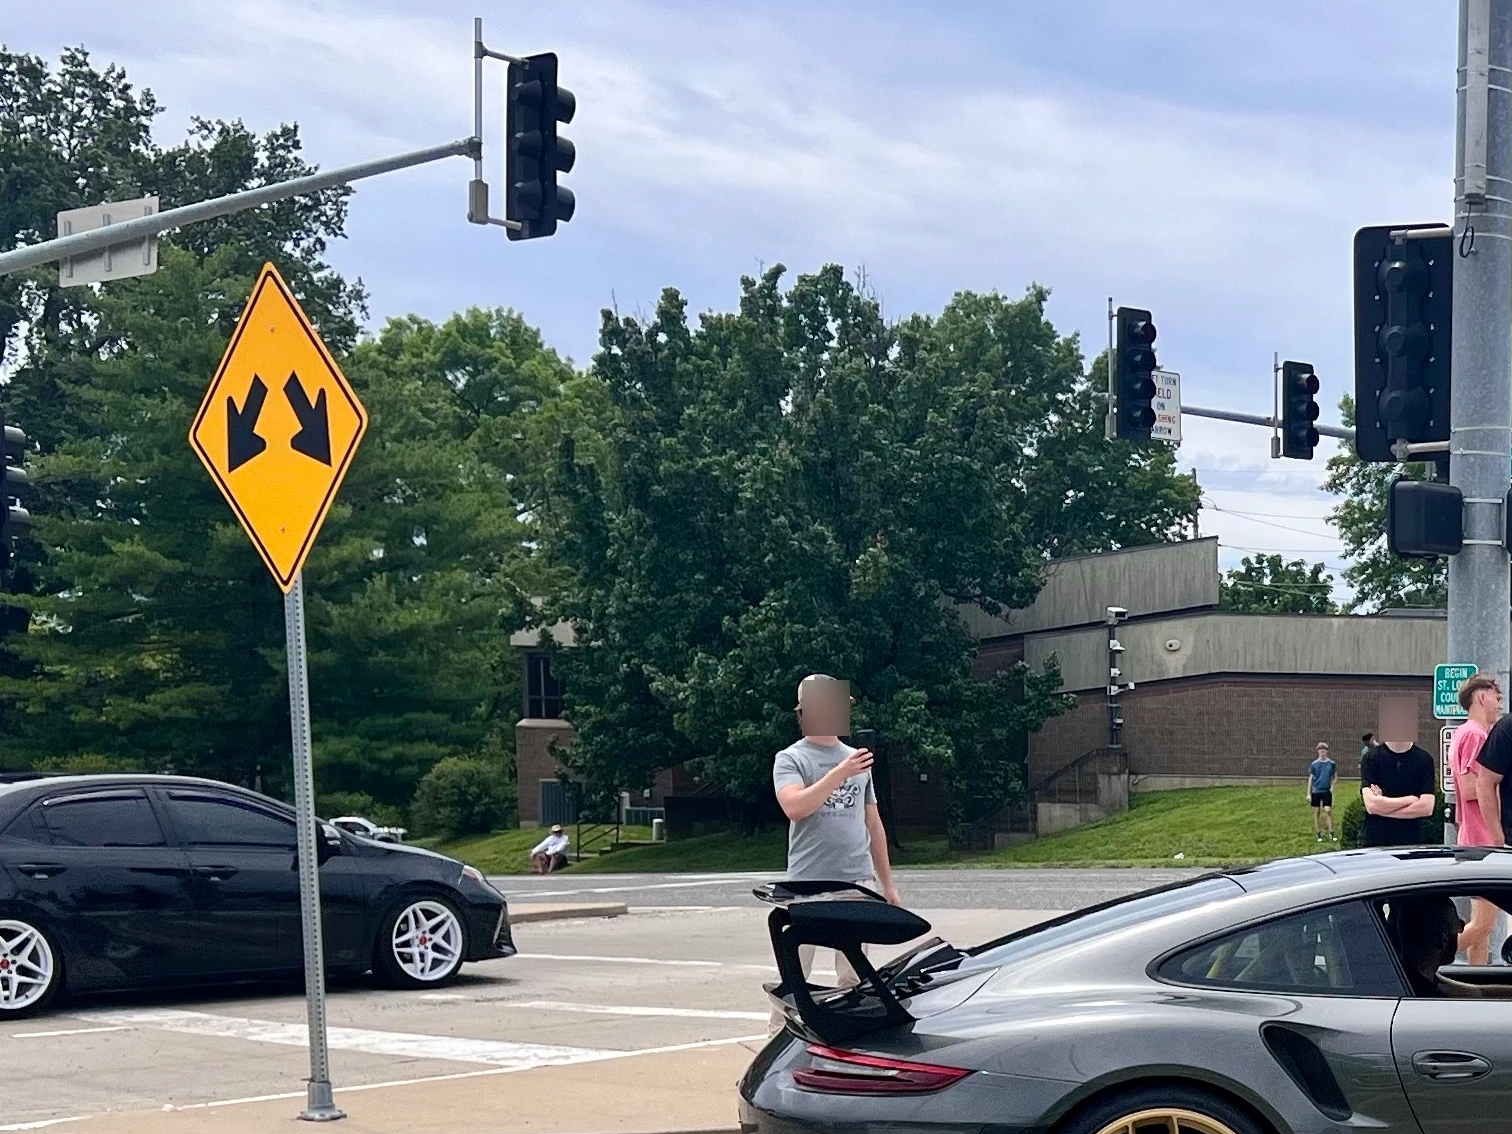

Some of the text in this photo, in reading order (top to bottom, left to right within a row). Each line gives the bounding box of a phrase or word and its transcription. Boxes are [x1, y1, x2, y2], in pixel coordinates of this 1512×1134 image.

[1155, 387, 1172, 400] ELD
[1444, 667, 1468, 679] BEGIN
[1437, 679, 1450, 691] ST.
